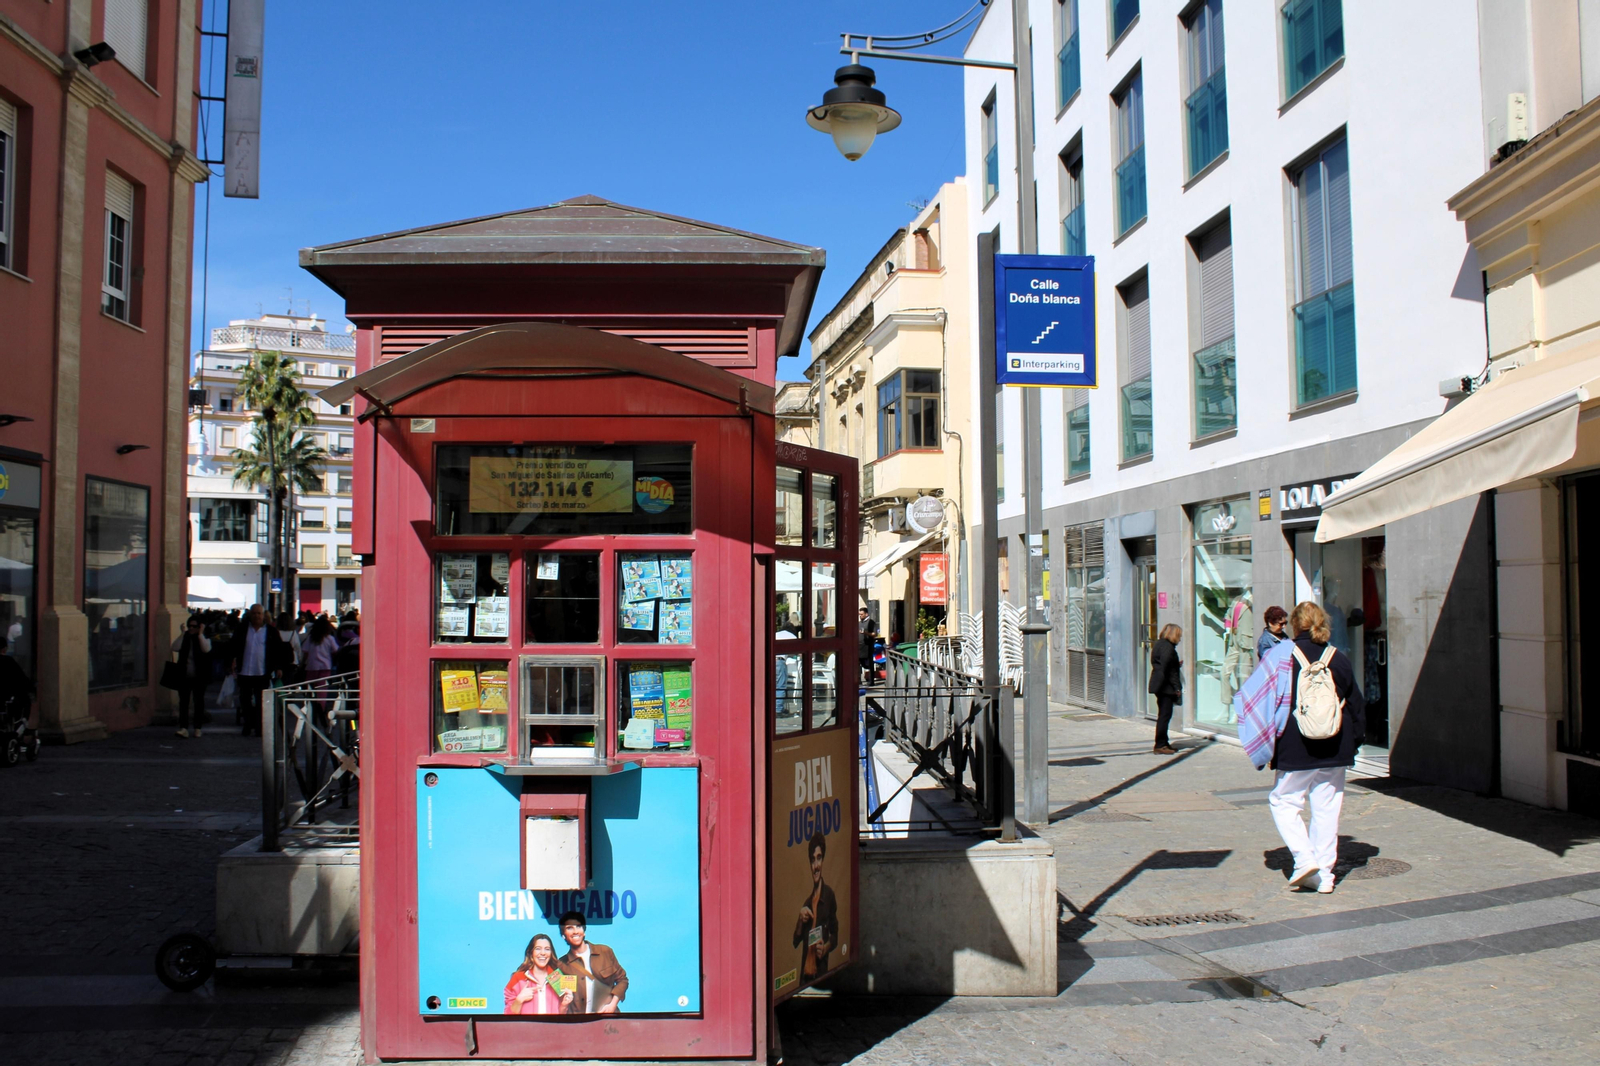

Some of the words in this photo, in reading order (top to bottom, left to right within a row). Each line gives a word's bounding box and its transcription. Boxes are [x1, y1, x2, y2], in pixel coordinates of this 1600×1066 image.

[1030, 279, 1060, 290] Calle
[1009, 293, 1040, 304] Doña
[1042, 294, 1081, 305] blanca
[1022, 359, 1080, 371] Interparking
[491, 471, 506, 479] San
[507, 471, 534, 480] Miguel
[535, 471, 545, 479] de
[546, 471, 576, 479] Salinas
[508, 481, 578, 497] 132.114
[581, 481, 594, 497] €
[635, 480, 652, 492] MI
[649, 482, 674, 501] DÍA
[1280, 484, 1326, 511] LOLA
[516, 501, 541, 509] Sorteo
[794, 755, 833, 807] BIEN
[787, 798, 841, 848] JUGADO
[478, 890, 535, 921] BIEN
[541, 889, 638, 920] JUGADO
[458, 999, 485, 1007] ONCE
